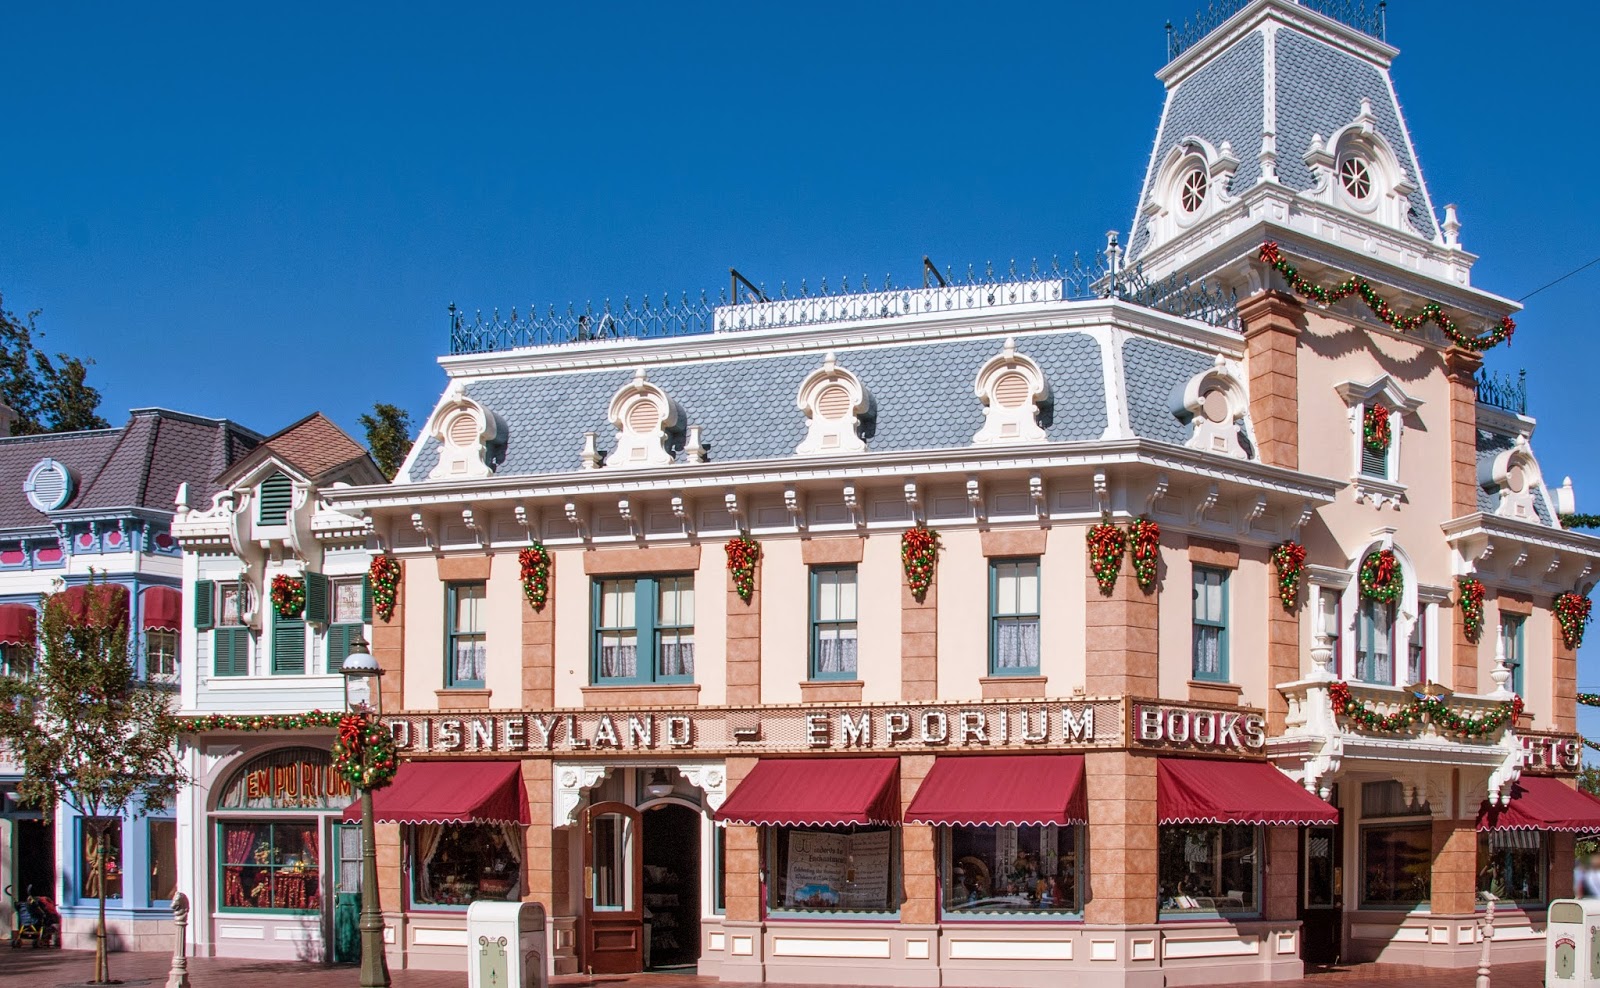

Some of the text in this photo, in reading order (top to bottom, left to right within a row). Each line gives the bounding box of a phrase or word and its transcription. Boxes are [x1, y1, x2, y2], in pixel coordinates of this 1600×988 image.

[388, 704, 1094, 748] DISNEYLAND EMPORIUM
[1138, 703, 1267, 749] BOOKS
[1528, 737, 1579, 767] FTS
[246, 762, 352, 797] EMPORIUM
